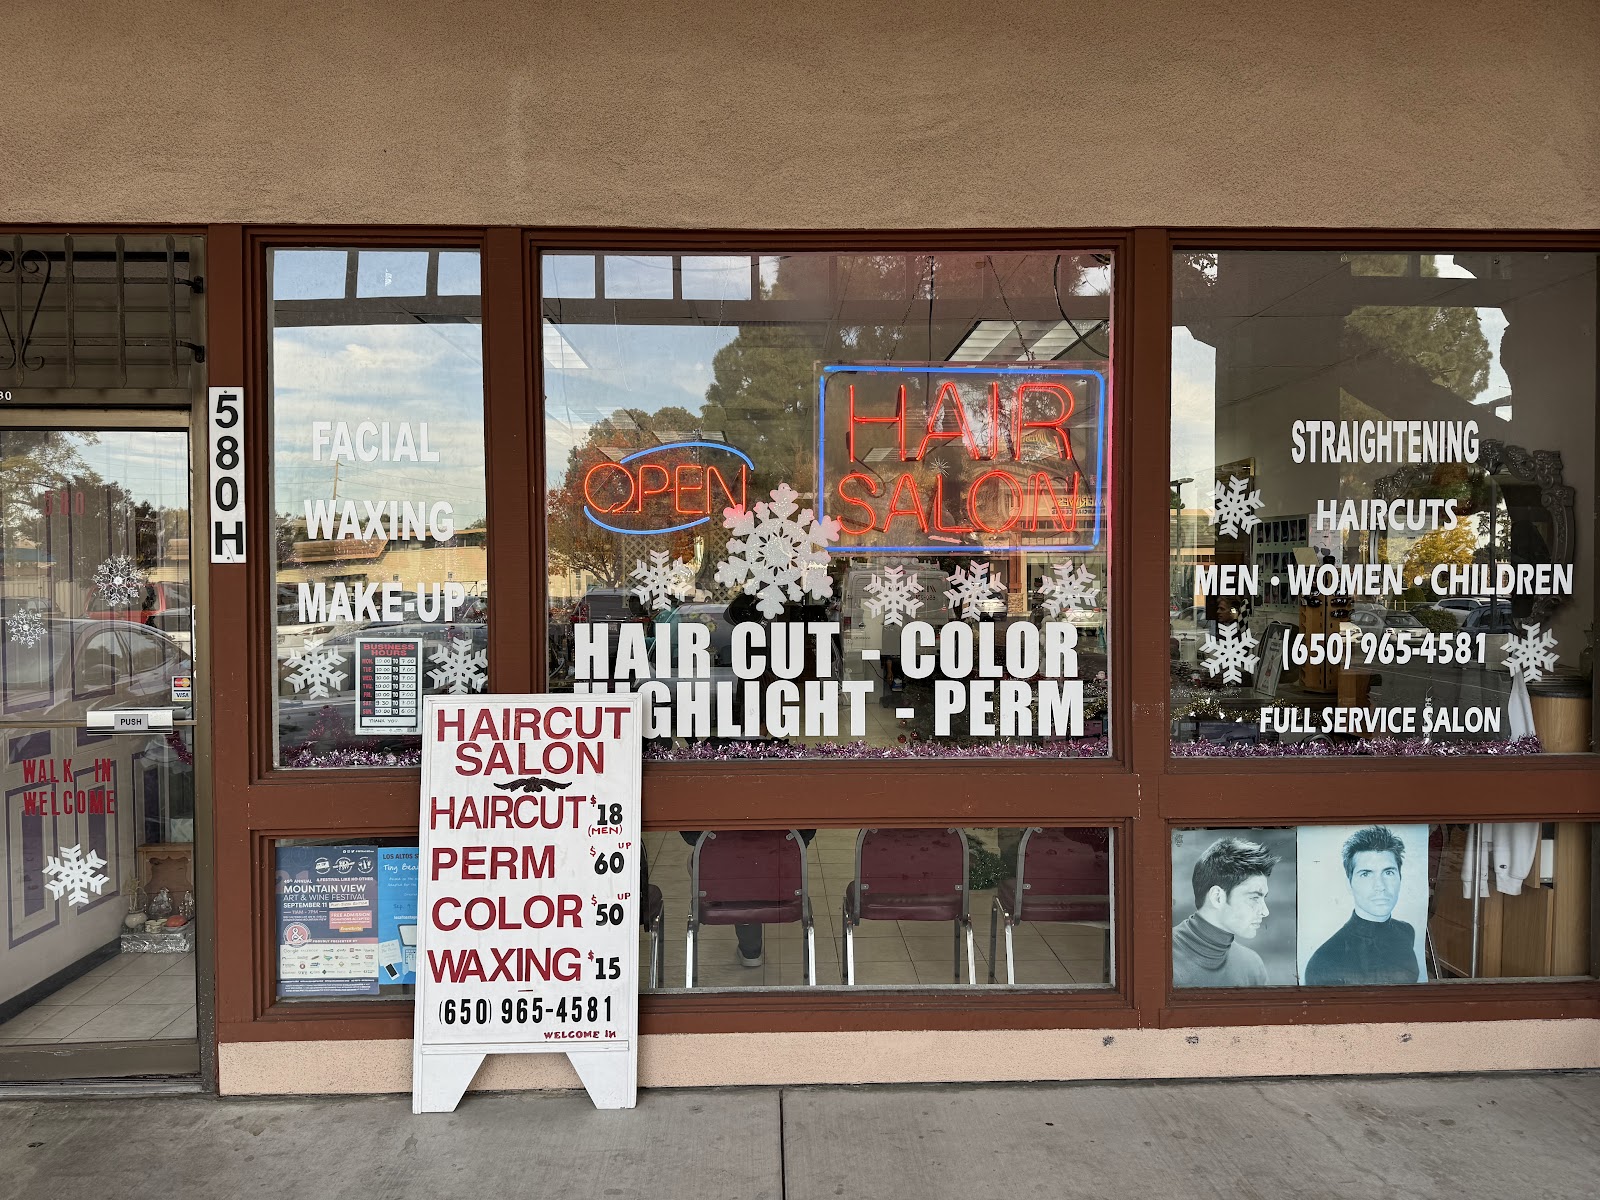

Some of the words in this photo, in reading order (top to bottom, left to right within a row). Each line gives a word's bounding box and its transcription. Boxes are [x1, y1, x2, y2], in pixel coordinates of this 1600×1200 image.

[848, 381, 1076, 463] HAIR
[312, 421, 440, 462] FACIAL
[1291, 420, 1480, 464] STRAIGHTENING
[584, 461, 748, 514] OPEN
[837, 470, 1080, 536] SALON
[304, 499, 455, 541] WAXING
[1317, 499, 1458, 531] HAIRCUTS
[1194, 564, 1258, 596] MEN
[1288, 564, 1403, 596] WOMEN
[1430, 563, 1573, 594] CHILDREN
[298, 582, 466, 622] MAKE-UP
[574, 622, 711, 679] HAIR
[730, 620, 840, 680] CUT
[900, 620, 1078, 678] COLOR
[1282, 628, 1351, 670] (650)
[1361, 632, 1486, 664] 965-4581
[437, 706, 630, 742] HAIRCUT
[574, 680, 874, 738] GHLIGHT
[934, 680, 1084, 738] PERM
[1260, 707, 1316, 733] FULL
[1322, 706, 1416, 733] SERVICE
[1422, 706, 1500, 732] SALON
[22, 758, 74, 783] WALK
[94, 758, 111, 782] IN
[455, 742, 604, 776] SALON
[23, 790, 115, 816] WELCOME
[430, 795, 586, 830] HAIRCUT
[590, 795, 623, 826] $18
[588, 826, 623, 837] (MEN)
[432, 845, 555, 881] PERM
[590, 846, 624, 875] $60
[284, 885, 338, 893] MOUNTAIN
[340, 884, 366, 892] VIEW
[432, 894, 583, 931] COLOR
[591, 894, 624, 926] $50
[427, 947, 582, 983] WAXING
[588, 950, 621, 980] $15
[439, 998, 492, 1025] (650)
[502, 996, 612, 1023] 965-4581
[544, 1030, 599, 1039] WELCOME
